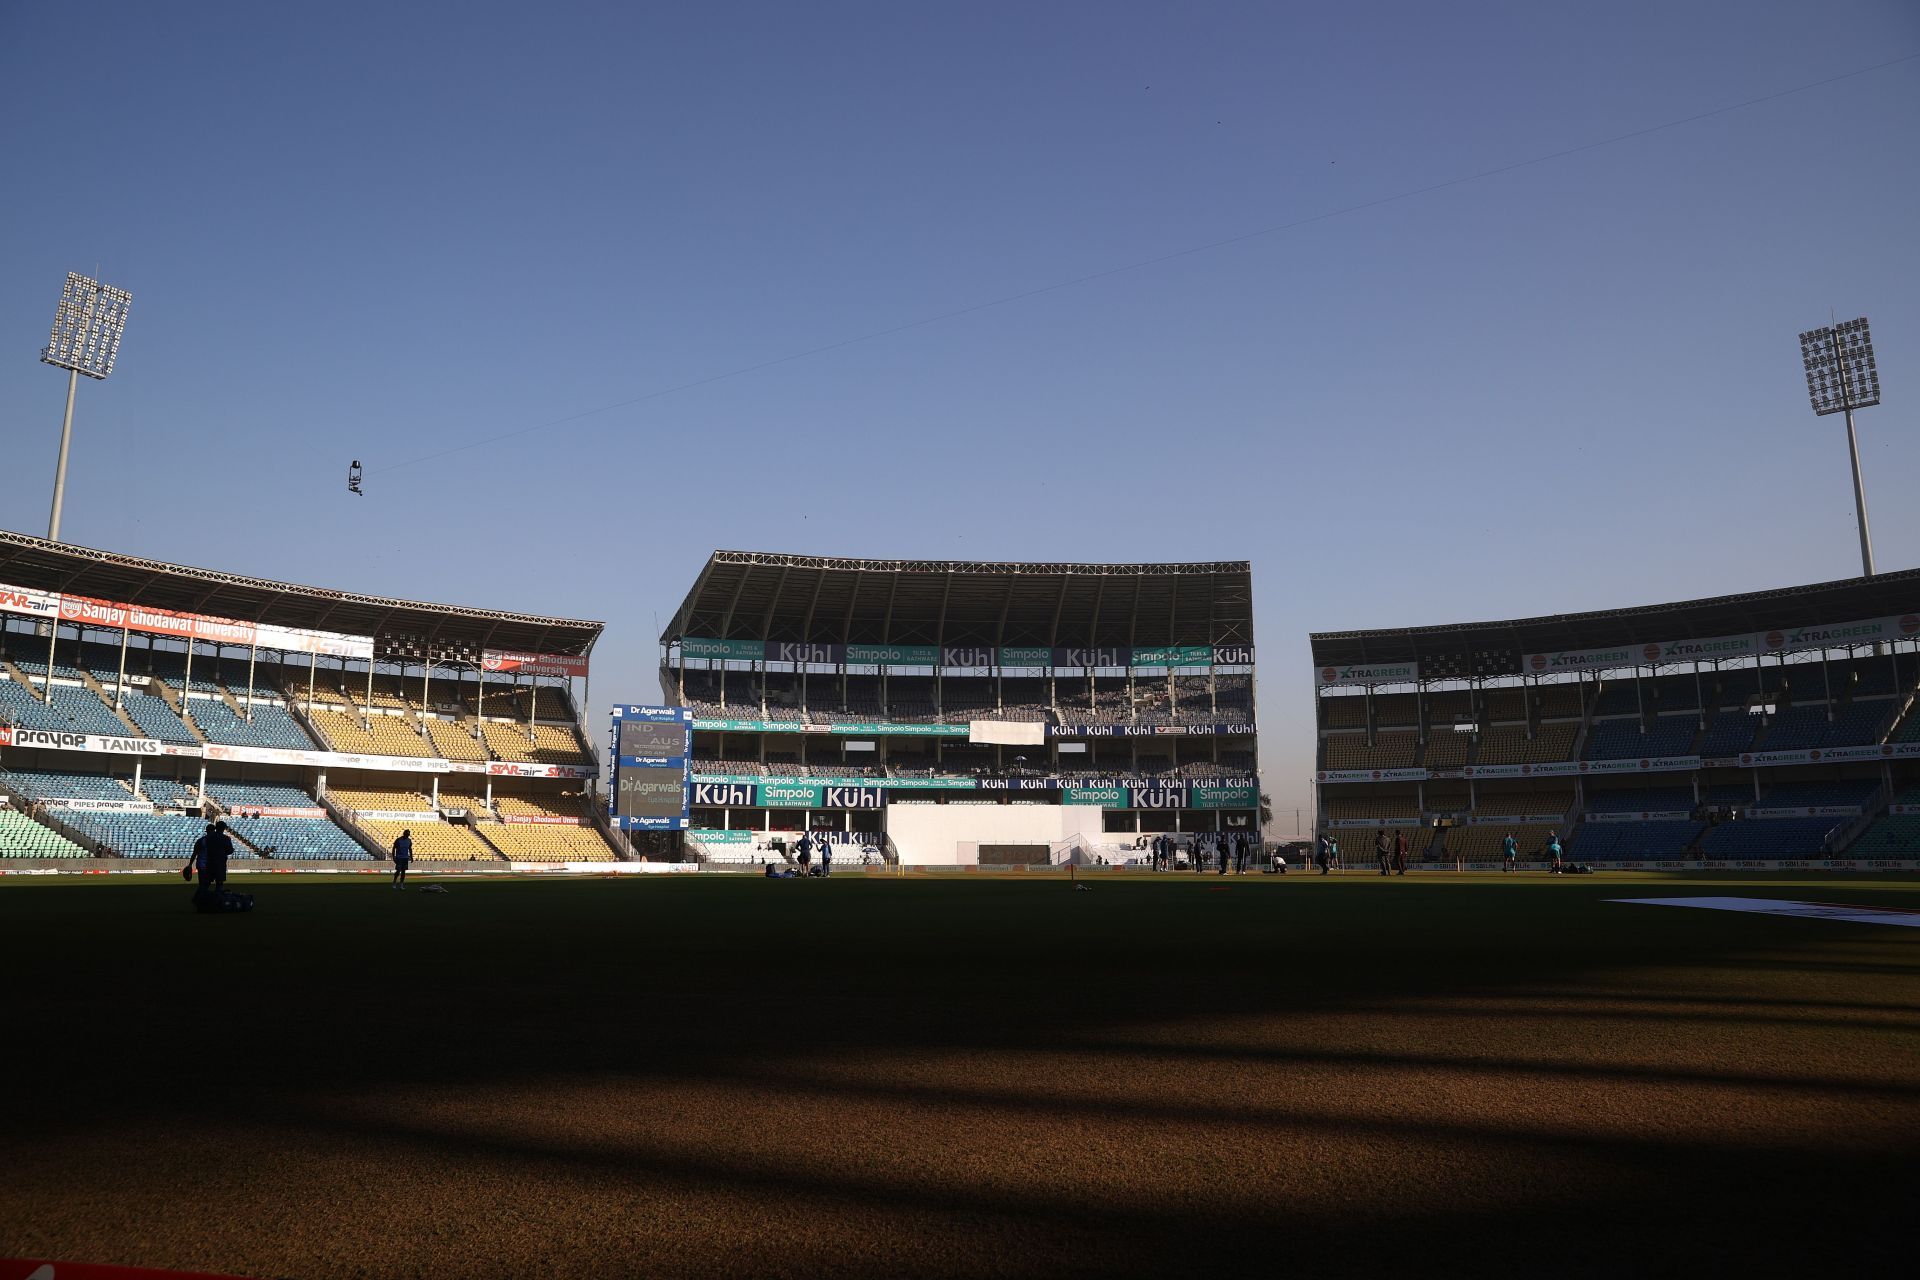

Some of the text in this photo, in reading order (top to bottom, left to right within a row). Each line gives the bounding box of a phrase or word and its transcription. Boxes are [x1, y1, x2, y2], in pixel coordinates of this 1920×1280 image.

[82, 603, 255, 645] Sanjay Ghodawat University
[681, 641, 731, 655] Simpolo
[780, 642, 832, 662] Kühl
[503, 651, 586, 666] Sanjay Ghodawat
[846, 646, 901, 661] Simpolo
[944, 648, 995, 666] Kühl
[1003, 649, 1049, 662] Simpolo
[1066, 648, 1117, 667] Kühl
[1132, 650, 1180, 664] Simpolo
[1213, 647, 1254, 663] Kühl
[520, 663, 568, 675] University
[630, 706, 640, 714] Dr
[640, 706, 676, 716] Agarwals
[692, 720, 727, 730] Simpolo
[762, 722, 798, 731] Simpolo
[878, 724, 904, 733] Simpolo
[1124, 725, 1150, 735] Kühl
[1188, 725, 1215, 734] Kühl
[1227, 724, 1254, 734] Kühl
[1052, 726, 1078, 735] Kühl
[1087, 726, 1113, 736] Kühl
[16, 730, 86, 748] prayag
[98, 738, 156, 752] TANKS
[650, 738, 680, 746] AUS
[488, 764, 520, 774] STAR
[518, 766, 542, 776] air
[545, 767, 576, 777] STAR
[692, 775, 729, 784] Simpolo
[758, 776, 794, 785] Simpolo
[798, 777, 834, 787] Simpolo
[864, 778, 898, 787] Simpolo
[982, 779, 1008, 788] Kühl
[1021, 779, 1046, 788] Kühl
[1057, 779, 1082, 788] Kühl
[1090, 779, 1116, 788] Kühl
[1122, 779, 1149, 788] Kühl
[1160, 779, 1186, 788] Kühl
[1193, 779, 1219, 788] Kühl
[1226, 778, 1252, 788] Kühl
[620, 780, 680, 795] Dr Agarwals
[695, 784, 752, 805] Kühl
[765, 786, 814, 800] Simpolo
[826, 787, 882, 808] Kühl
[1070, 790, 1119, 801] Simpolo
[1133, 788, 1186, 808] Kühl
[1200, 790, 1249, 801] Simpolo
[512, 816, 532, 824] Sanjay
[640, 817, 670, 825] Agarwals
[809, 832, 842, 844] Kühl
[850, 832, 882, 844] Kühl
